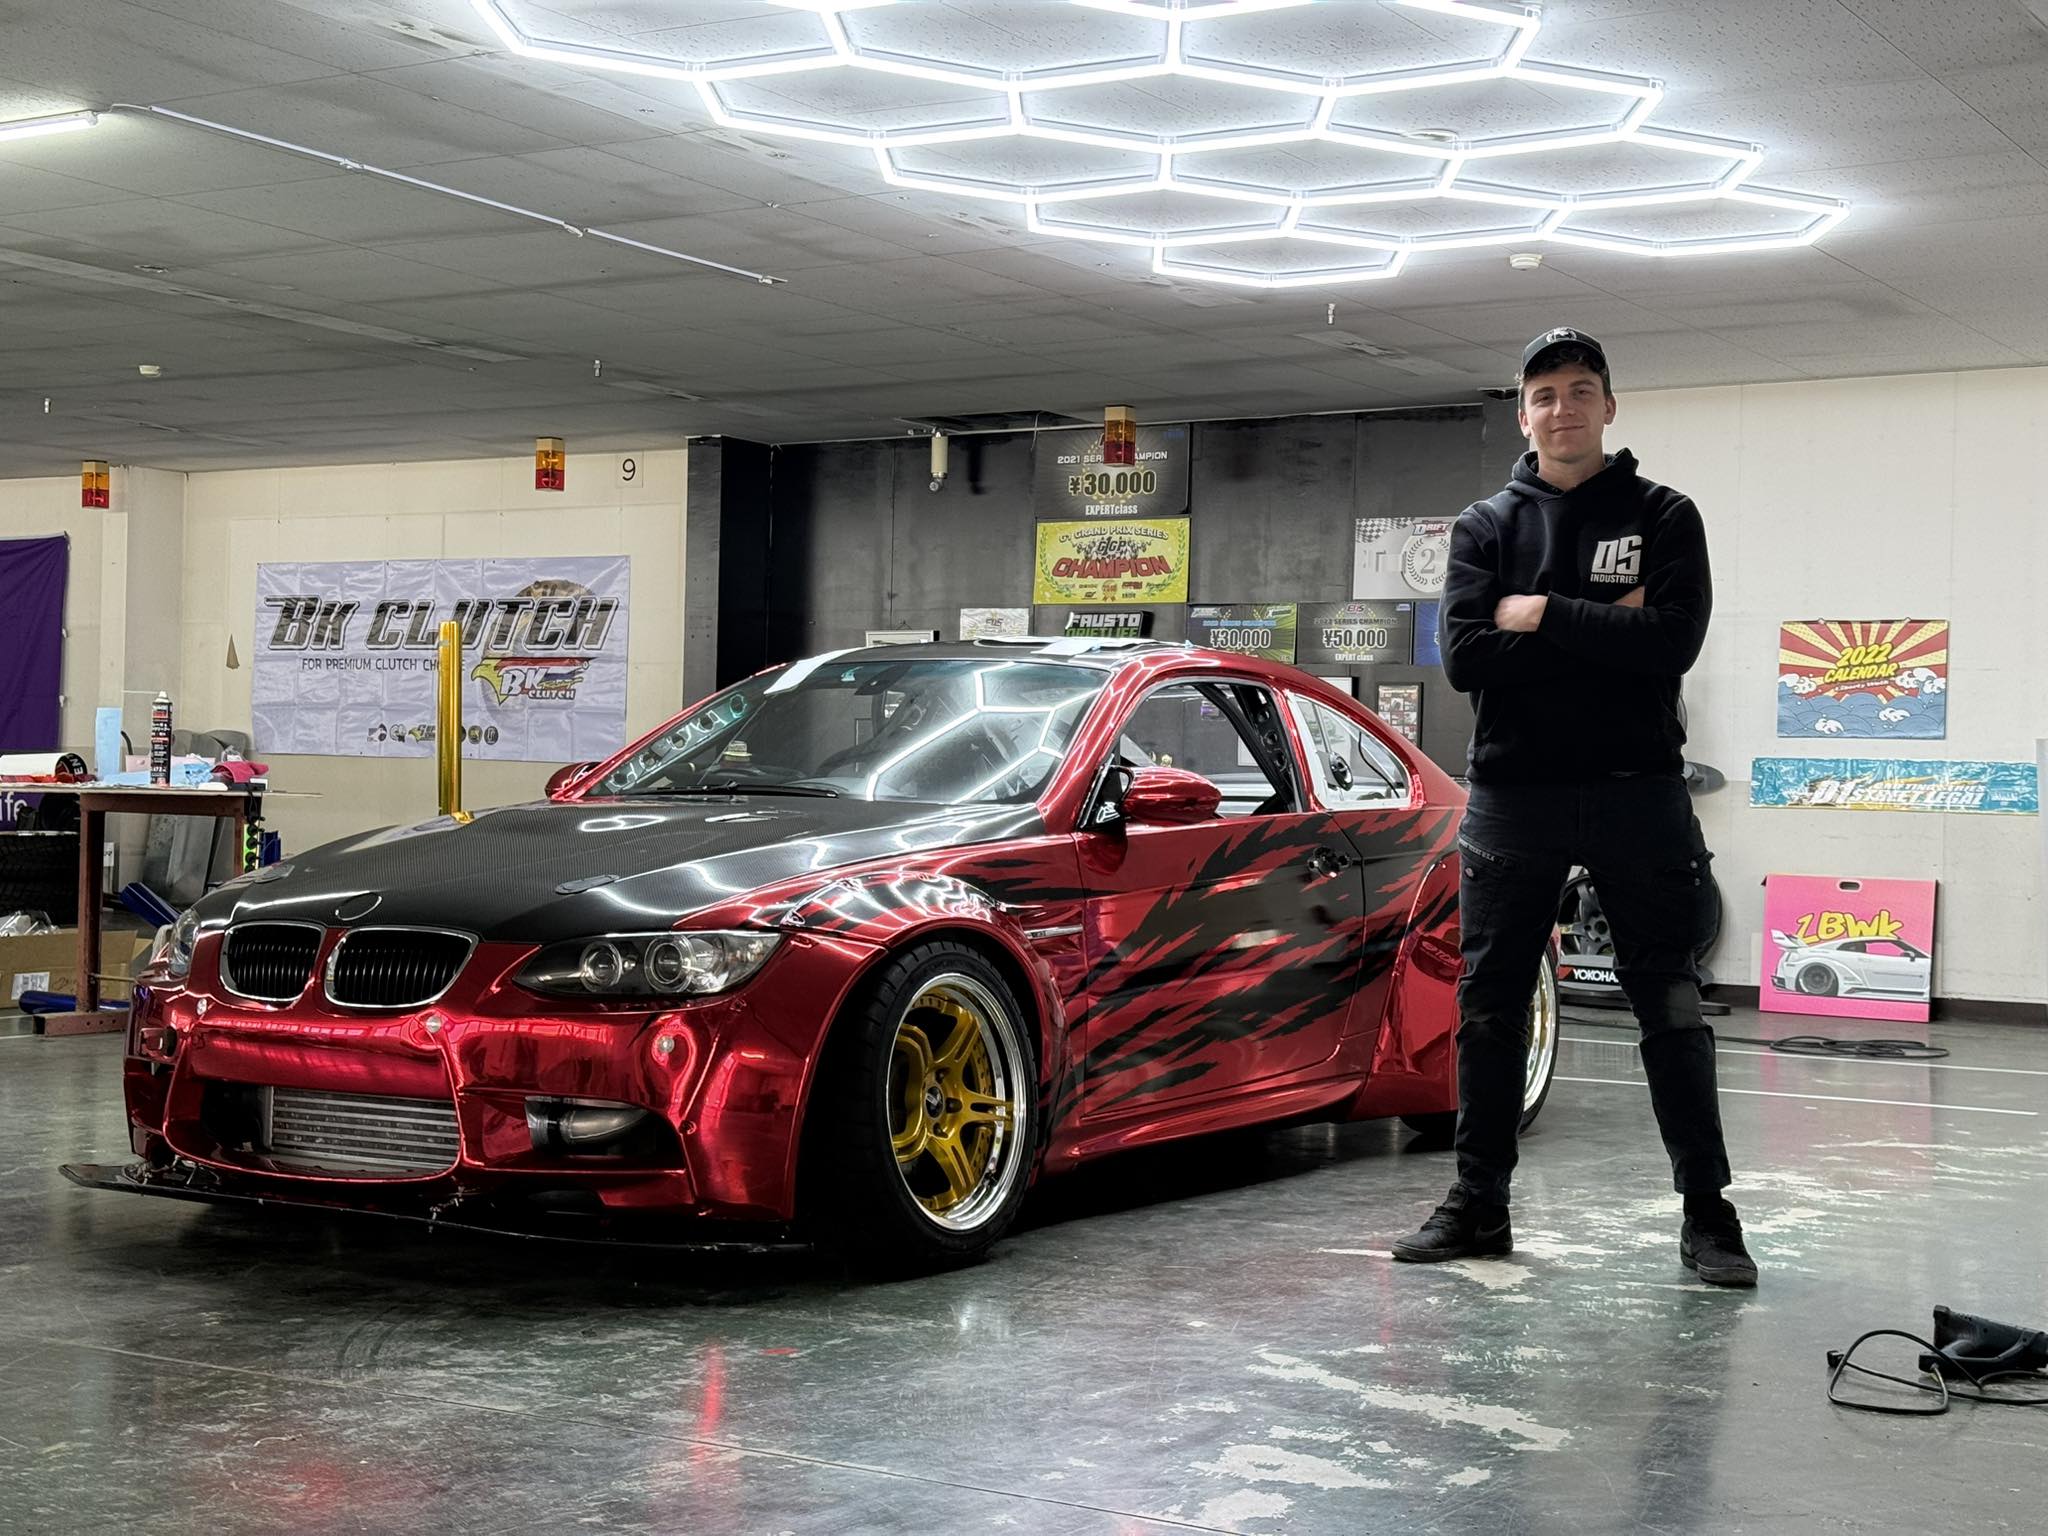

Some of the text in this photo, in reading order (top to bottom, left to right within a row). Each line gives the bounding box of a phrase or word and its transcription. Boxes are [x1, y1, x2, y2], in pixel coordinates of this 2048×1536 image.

[1057, 451, 1168, 464] 2021 SER AMPION
[622, 458, 636, 481] 9
[1068, 469, 1157, 497] ¥30,000
[1073, 526, 1108, 539] GRAND
[1109, 525, 1134, 537] PRIX
[1135, 526, 1169, 541] SERIES
[1051, 555, 1173, 579] CHAMPION
[1420, 548, 1437, 574] 2
[1590, 573, 1639, 585] INDUSTRIES
[263, 594, 620, 651] BK CLUTCH
[1068, 613, 1141, 628] FAUSTO
[1210, 628, 1271, 650] ¥30,000
[1322, 628, 1388, 649] ¥50,000
[302, 658, 322, 671] FOR
[326, 658, 371, 671] PREMIUM
[375, 658, 417, 671] CLUTCH
[1835, 641, 1894, 668] 2022
[500, 667, 549, 697] BK
[1823, 662, 1900, 684] CALENDAR
[528, 687, 577, 700] CLUTCH
[1573, 968, 1619, 983] YOKOHA
